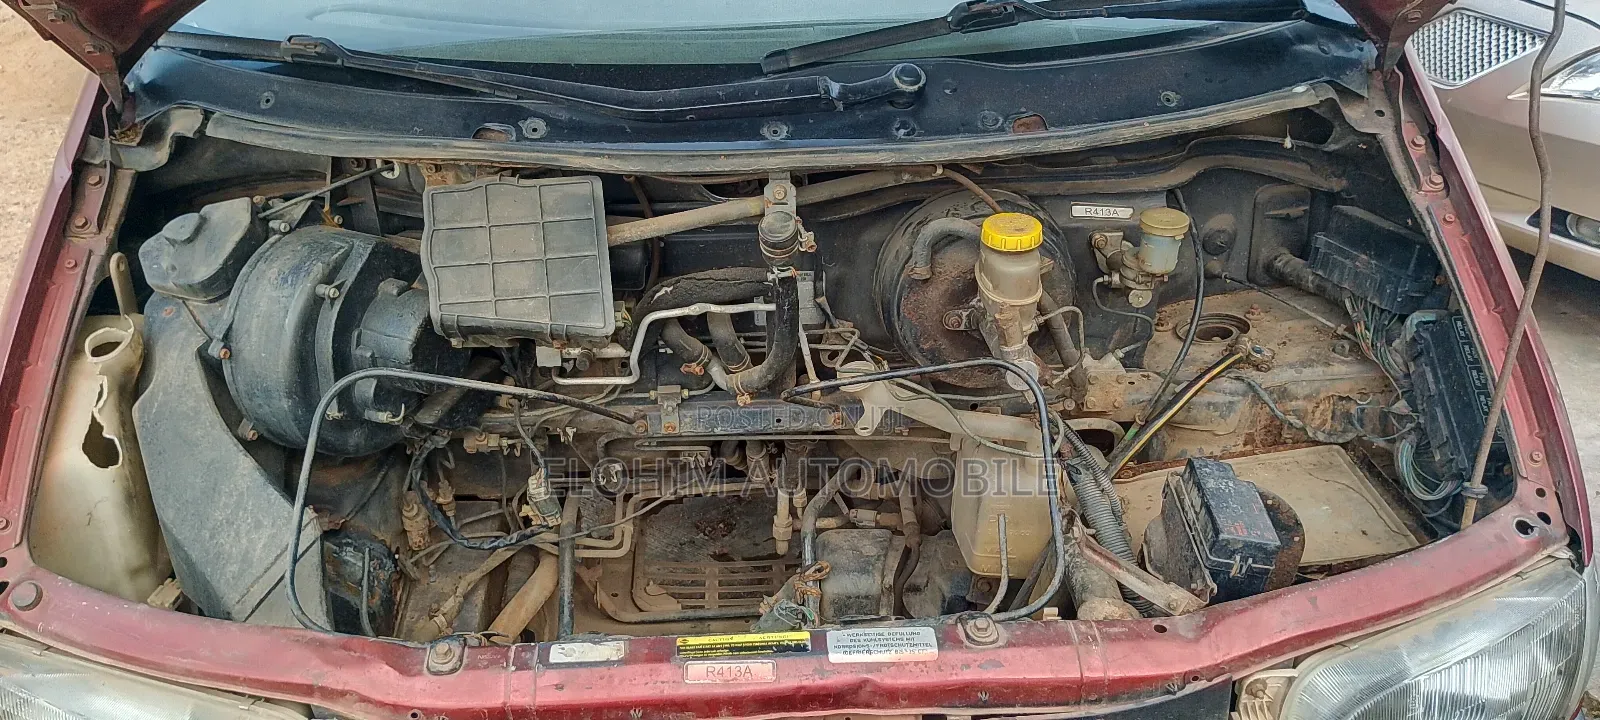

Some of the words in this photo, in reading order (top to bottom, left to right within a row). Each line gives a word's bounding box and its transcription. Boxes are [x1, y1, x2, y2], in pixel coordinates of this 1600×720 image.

[1084, 207, 1120, 217] R413A
[1463, 344, 1474, 362] RELAY
[1471, 369, 1482, 387] RELAY
[1479, 394, 1490, 412] RELAY
[706, 665, 753, 678] R413A
